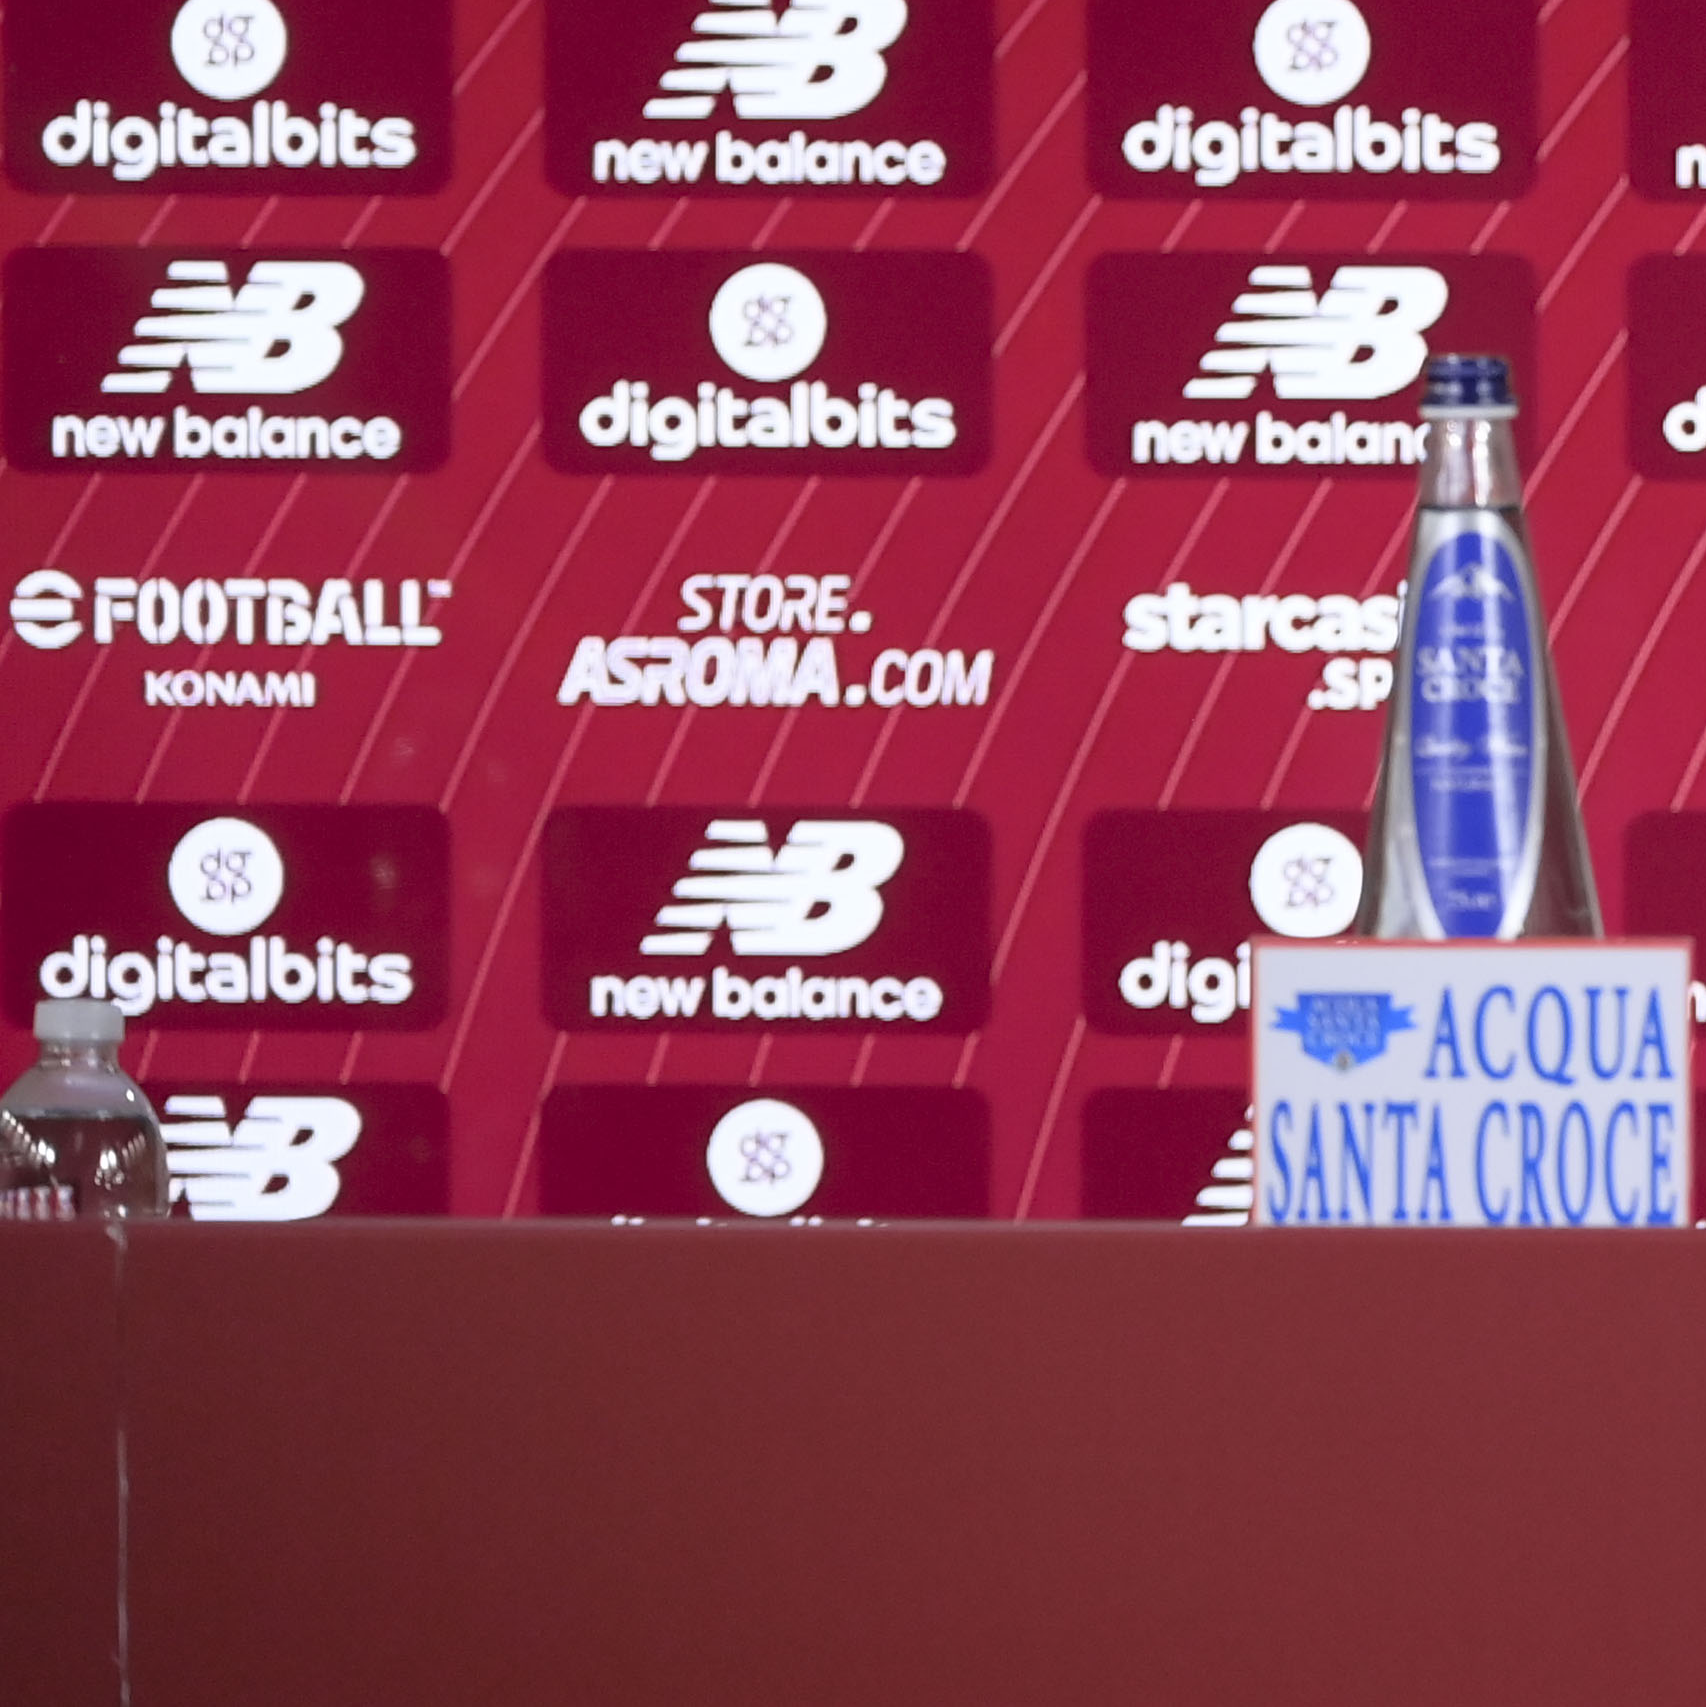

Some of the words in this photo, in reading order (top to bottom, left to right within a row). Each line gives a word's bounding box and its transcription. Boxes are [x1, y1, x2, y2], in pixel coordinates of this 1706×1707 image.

[42, 103, 416, 180] digitalbits
[594, 139, 709, 183] new
[716, 131, 946, 184] balance
[1122, 108, 1500, 186] digitalbits
[52, 415, 165, 457] new
[174, 406, 401, 459] balance
[579, 383, 956, 461] digitalbits
[145, 670, 315, 707] KONAMI
[557, 637, 994, 707] ASROMA.COM
[40, 935, 413, 1016] digitalbits
[591, 976, 705, 1019] new
[713, 967, 943, 1021] balance
[1423, 984, 1676, 1086] ACQUA
[1266, 1099, 1454, 1225] SANTA
[1474, 1099, 1679, 1225] CROCE
